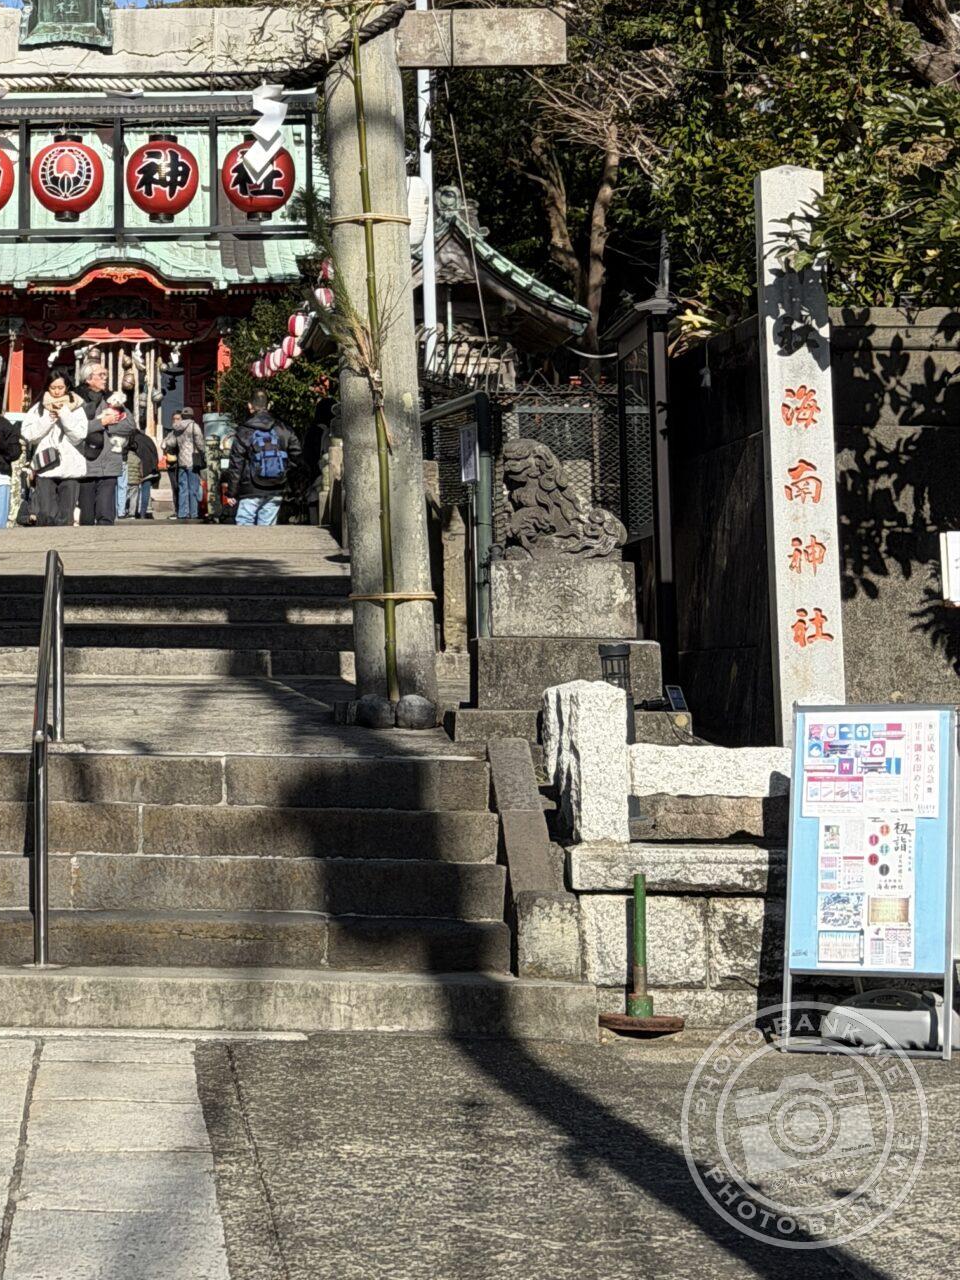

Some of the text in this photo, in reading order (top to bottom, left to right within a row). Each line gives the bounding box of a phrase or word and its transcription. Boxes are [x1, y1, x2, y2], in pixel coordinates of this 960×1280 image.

[136, 150, 192, 200] 神
[781, 385, 834, 648] 海南神社
[894, 818, 911, 853] 初詣
